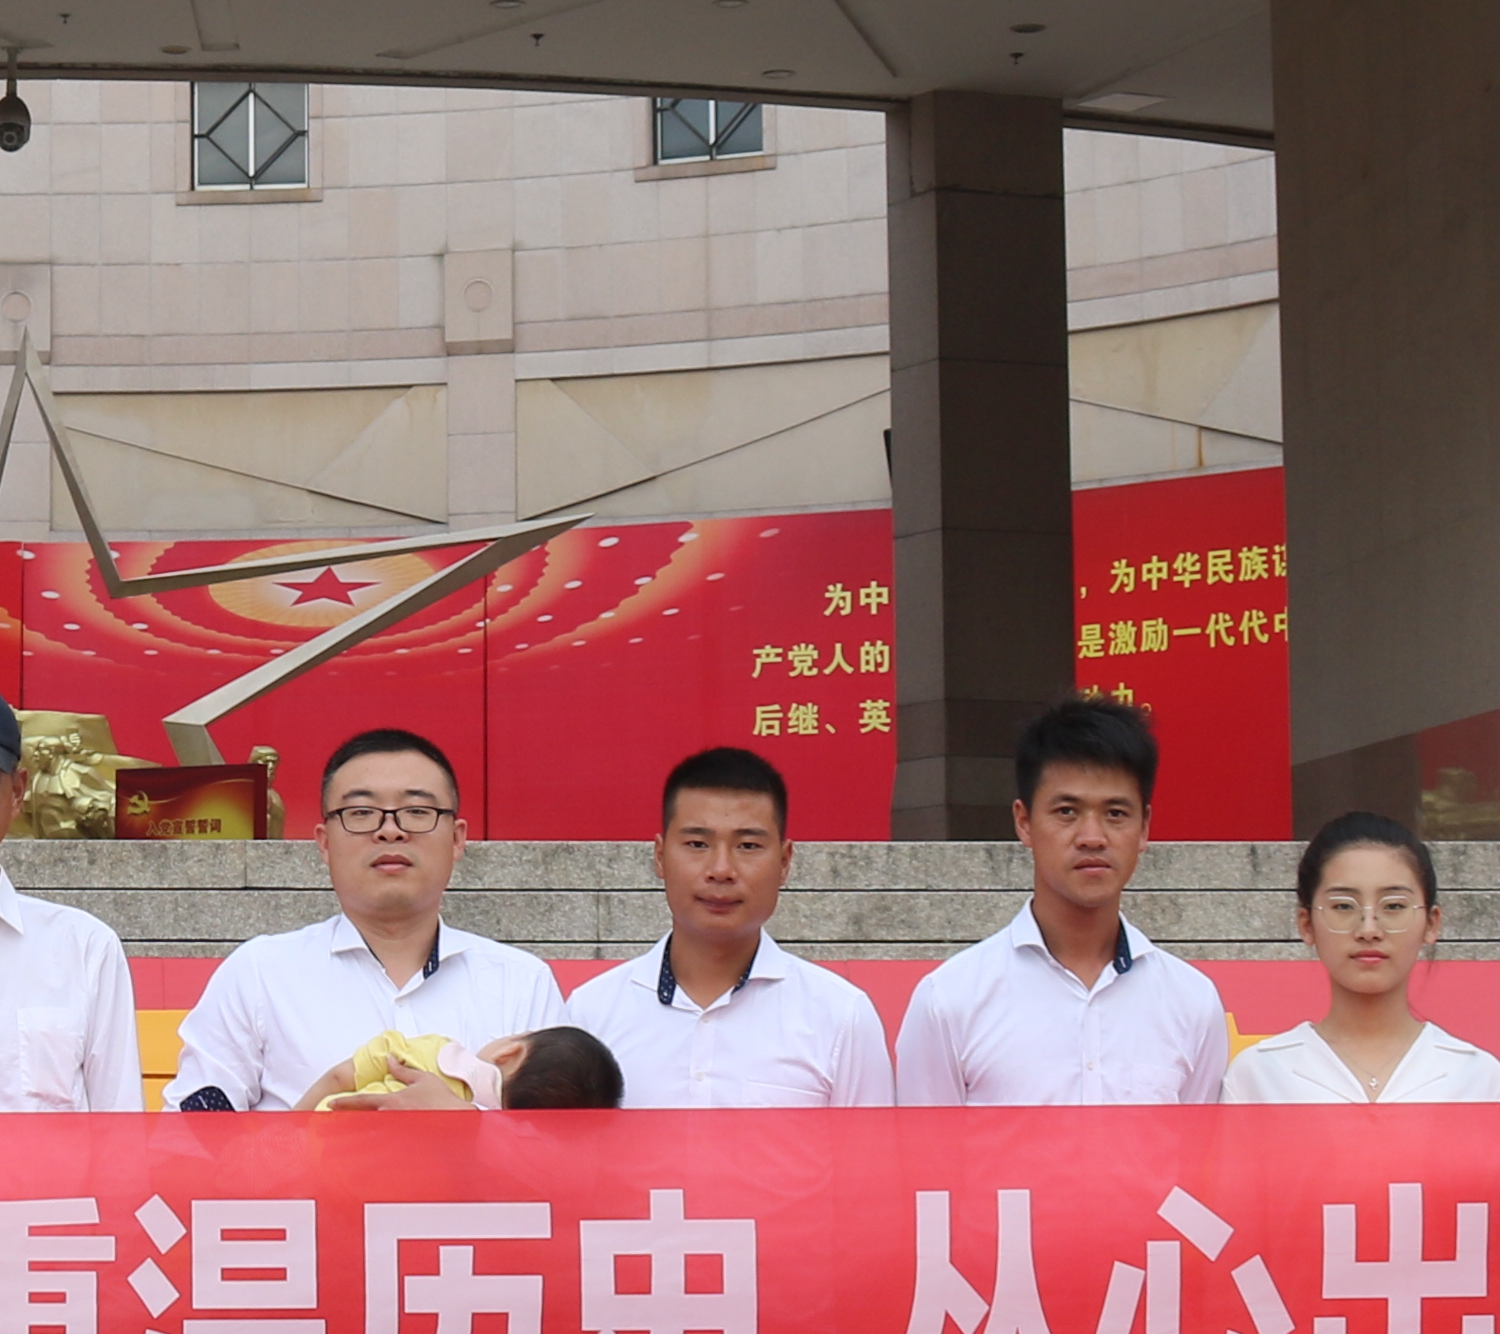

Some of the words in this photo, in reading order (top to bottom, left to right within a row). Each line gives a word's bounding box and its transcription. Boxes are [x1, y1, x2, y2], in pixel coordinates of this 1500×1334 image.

[823, 580, 890, 617] 为中
[752, 640, 891, 679] 产党人的
[752, 699, 892, 737] 后继、英
